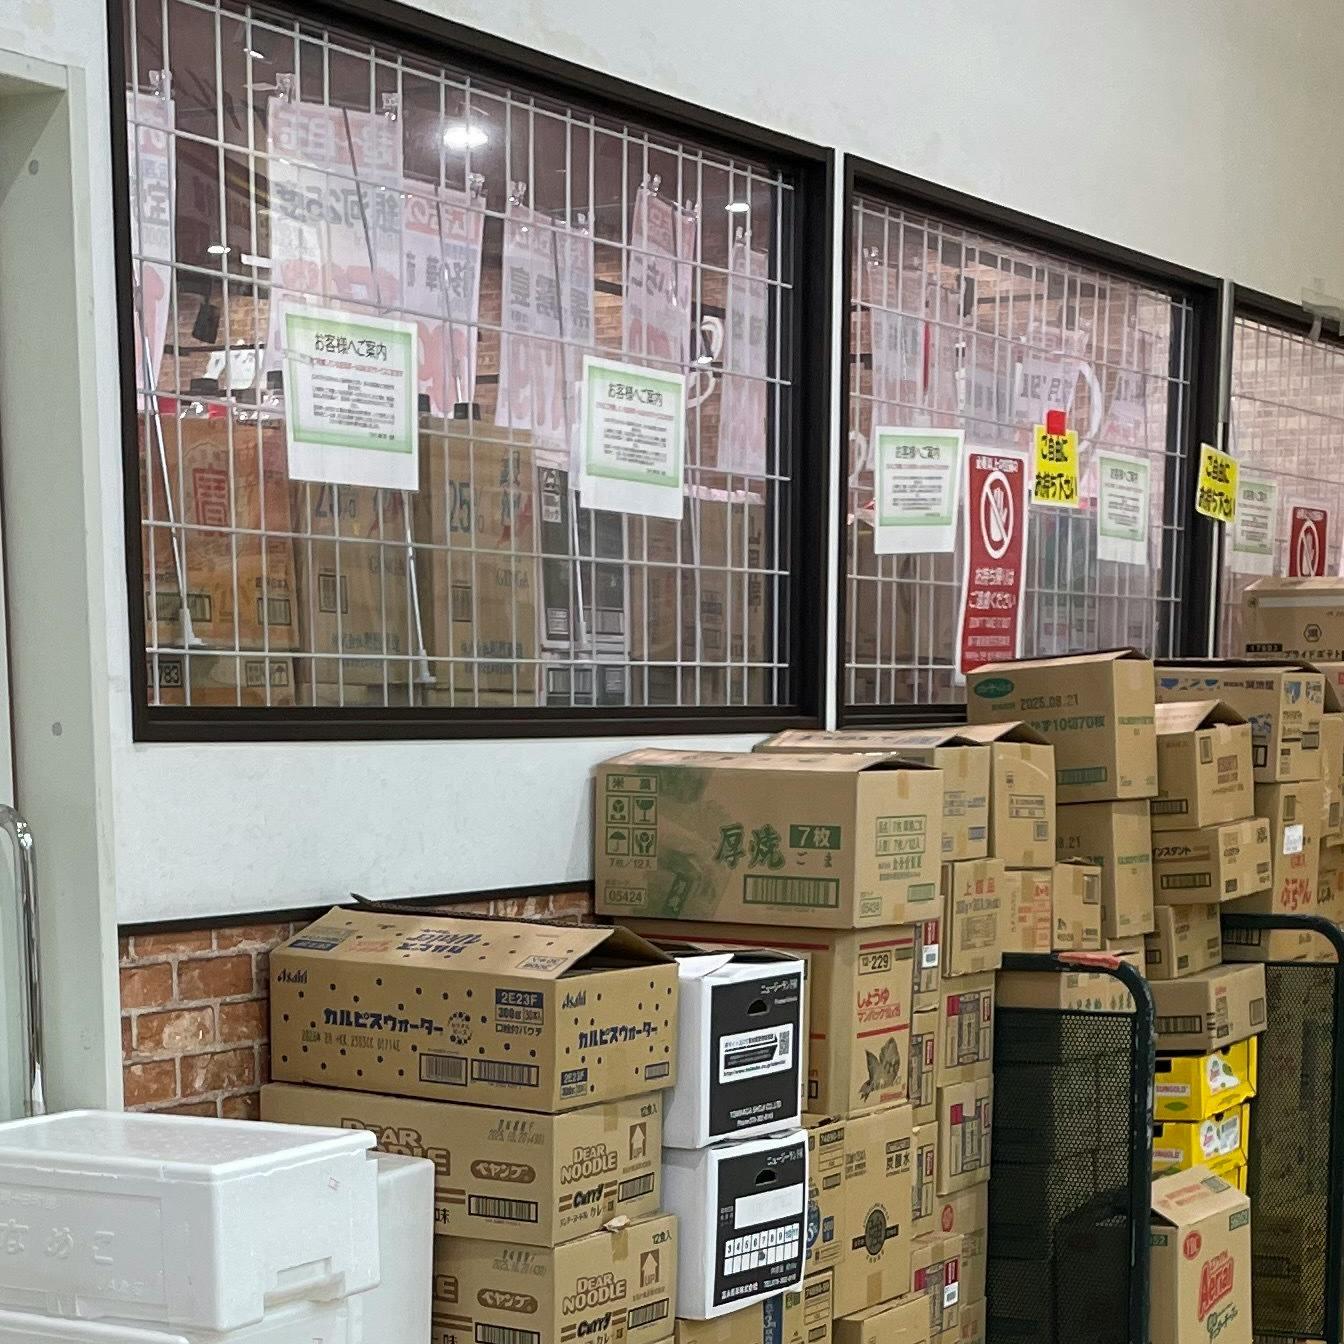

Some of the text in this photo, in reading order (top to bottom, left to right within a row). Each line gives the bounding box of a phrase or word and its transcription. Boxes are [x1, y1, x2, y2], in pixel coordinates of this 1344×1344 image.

[315, 333, 388, 361] お客様へご案内
[716, 823, 786, 871] 厚焼
[798, 826, 832, 848] 7枚
[607, 890, 643, 904] 05424
[277, 968, 307, 984] Asahi
[501, 990, 538, 1006] 2E23F
[857, 988, 890, 1009] しょうゆ
[324, 1007, 443, 1036] カルピスウォーター
[578, 1021, 657, 1050] カルピスウォーター
[572, 1143, 607, 1161] DEAR
[474, 1162, 531, 1181] ペヤング
[560, 1150, 618, 1184] NOODLE
[573, 1184, 604, 1208] Curry
[577, 1272, 613, 1294] DEAR
[480, 1290, 533, 1308] ペヤング
[562, 1279, 627, 1315] NOODLE
[577, 1312, 612, 1337] Curry
